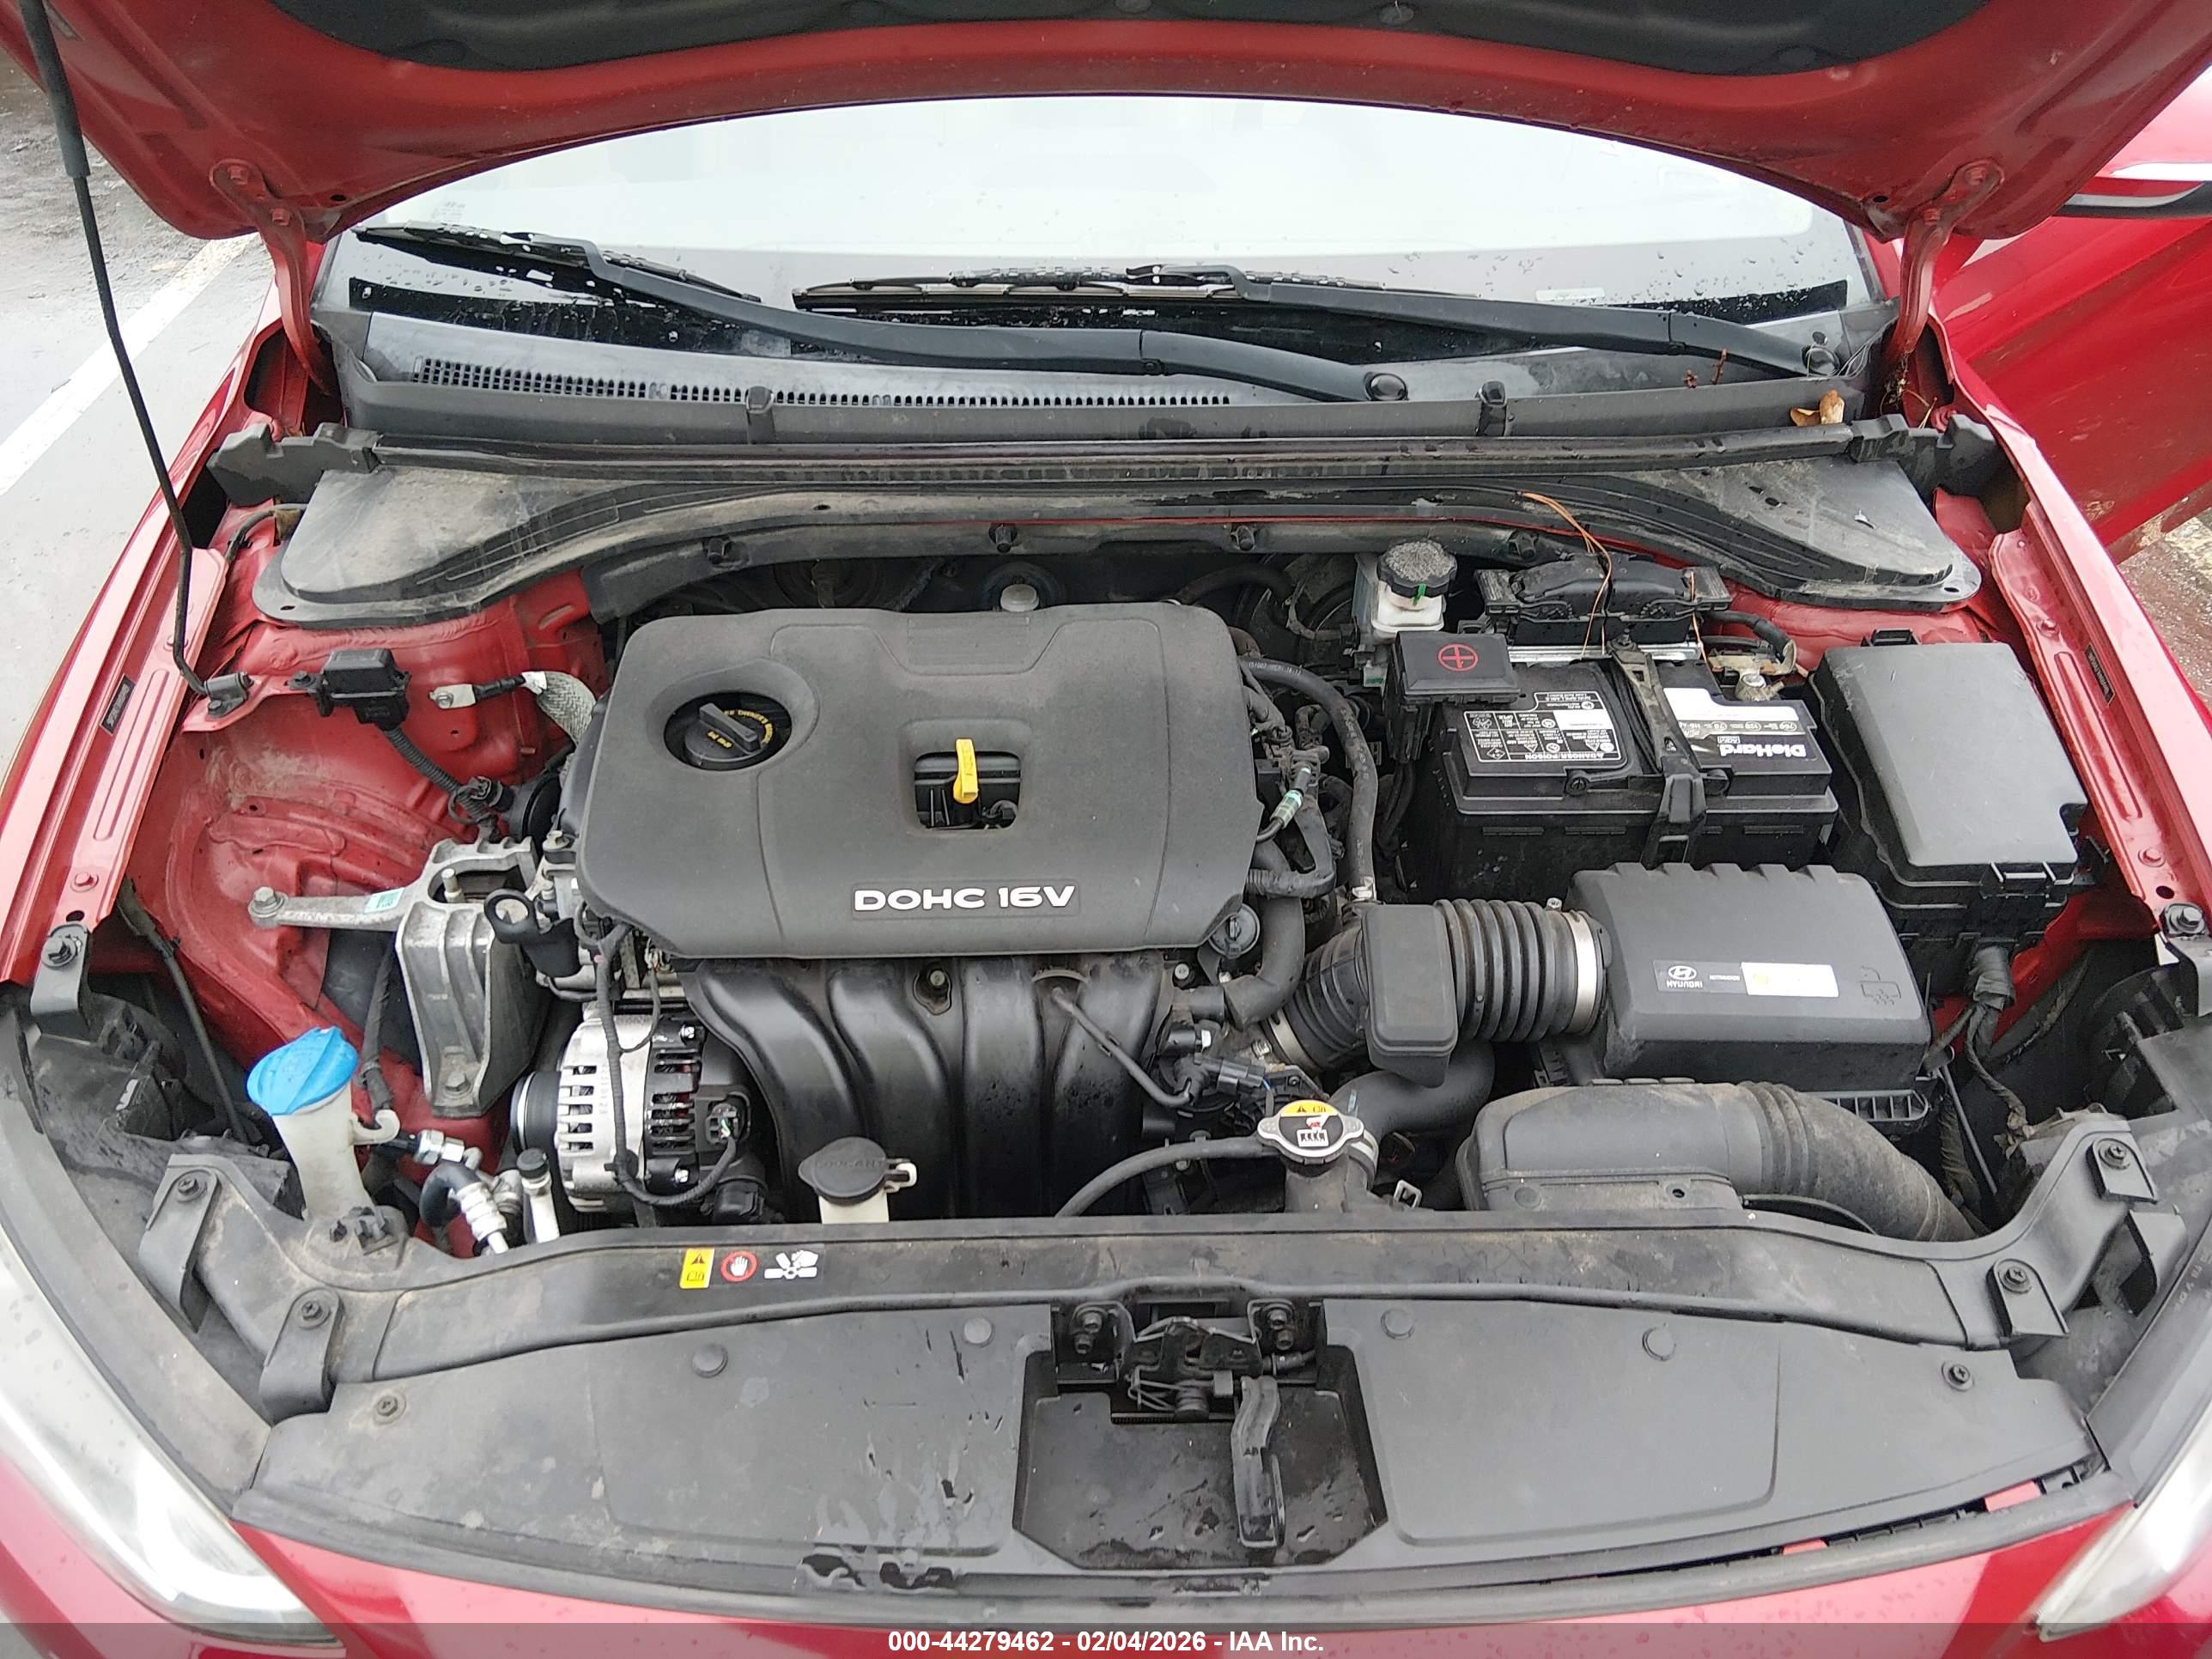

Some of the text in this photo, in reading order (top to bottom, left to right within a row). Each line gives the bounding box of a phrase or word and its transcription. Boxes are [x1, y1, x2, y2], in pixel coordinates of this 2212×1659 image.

[1719, 744, 1807, 757] DieHard
[854, 885, 1075, 911] DOHC 16V
[1666, 980, 1704, 988] HYUNDAI
